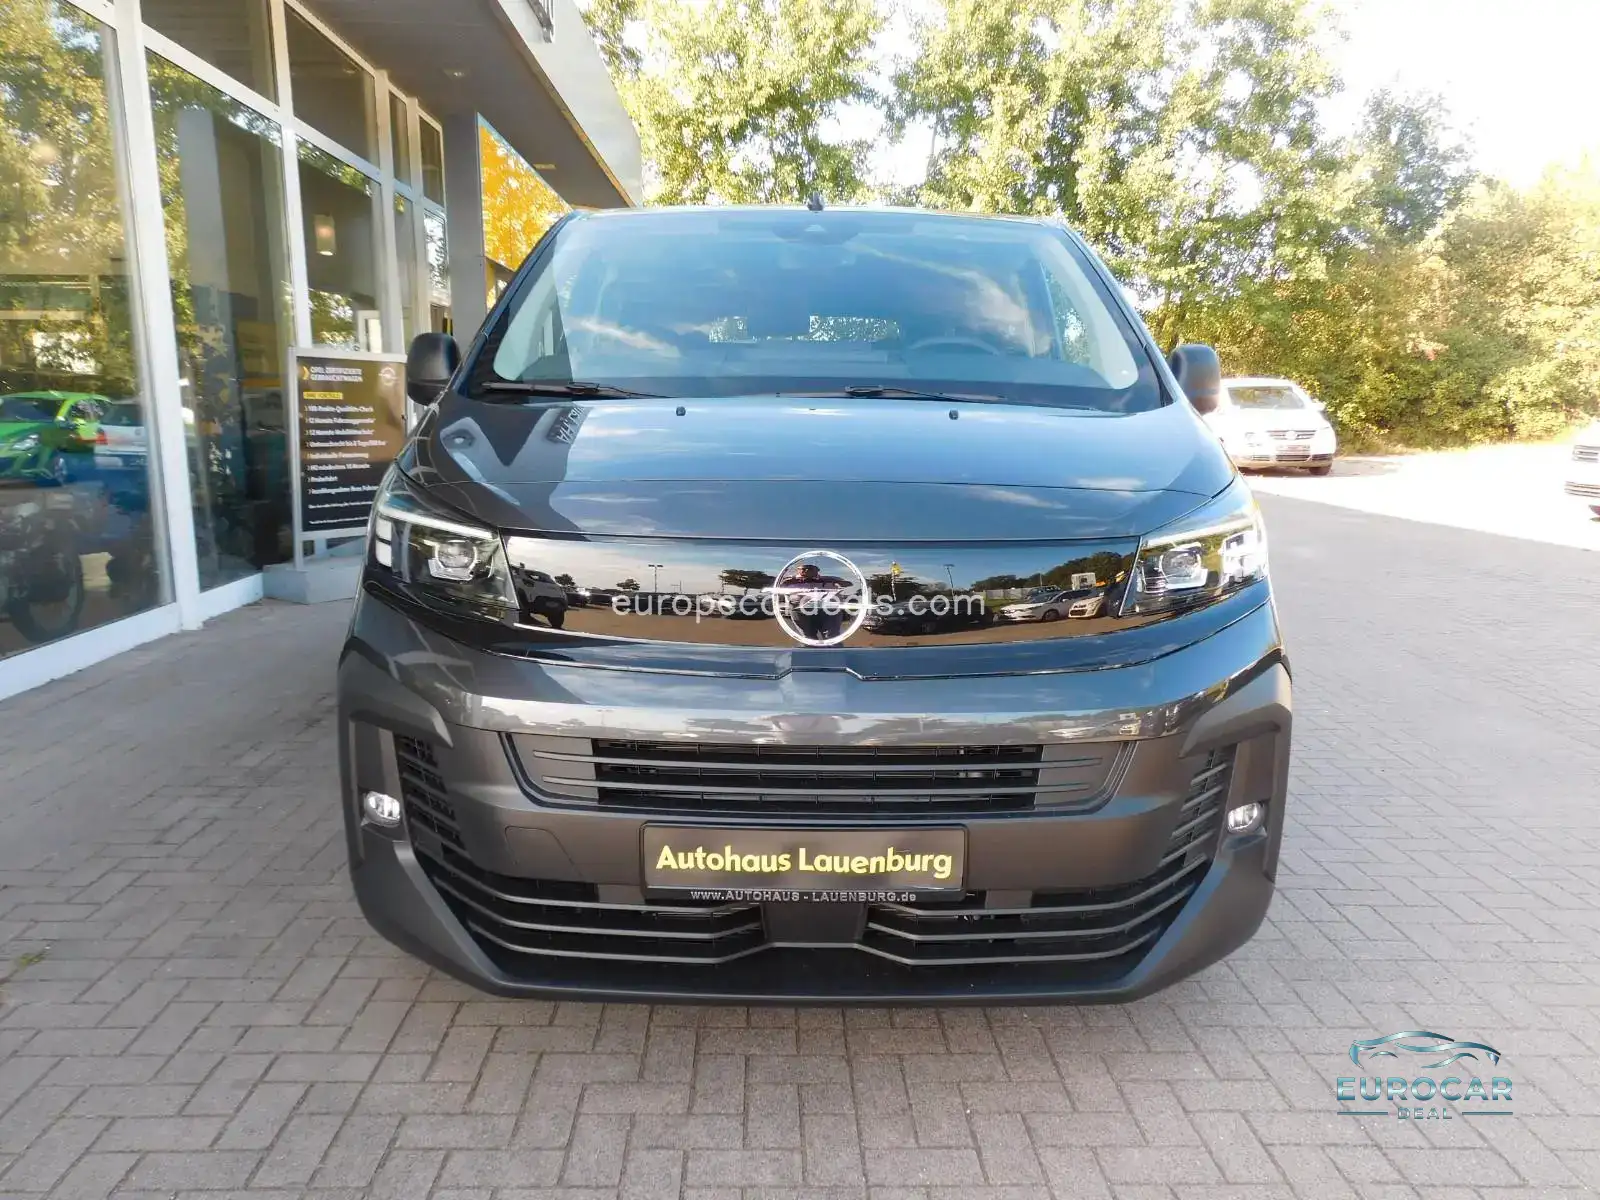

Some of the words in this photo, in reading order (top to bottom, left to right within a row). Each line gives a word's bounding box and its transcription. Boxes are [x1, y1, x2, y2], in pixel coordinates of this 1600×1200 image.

[656, 845, 791, 872] Autohaus
[798, 846, 952, 879] Lauenburg
[691, 890, 800, 902] www.AUTOHAUS
[812, 891, 917, 902] LAUENBURG.de
